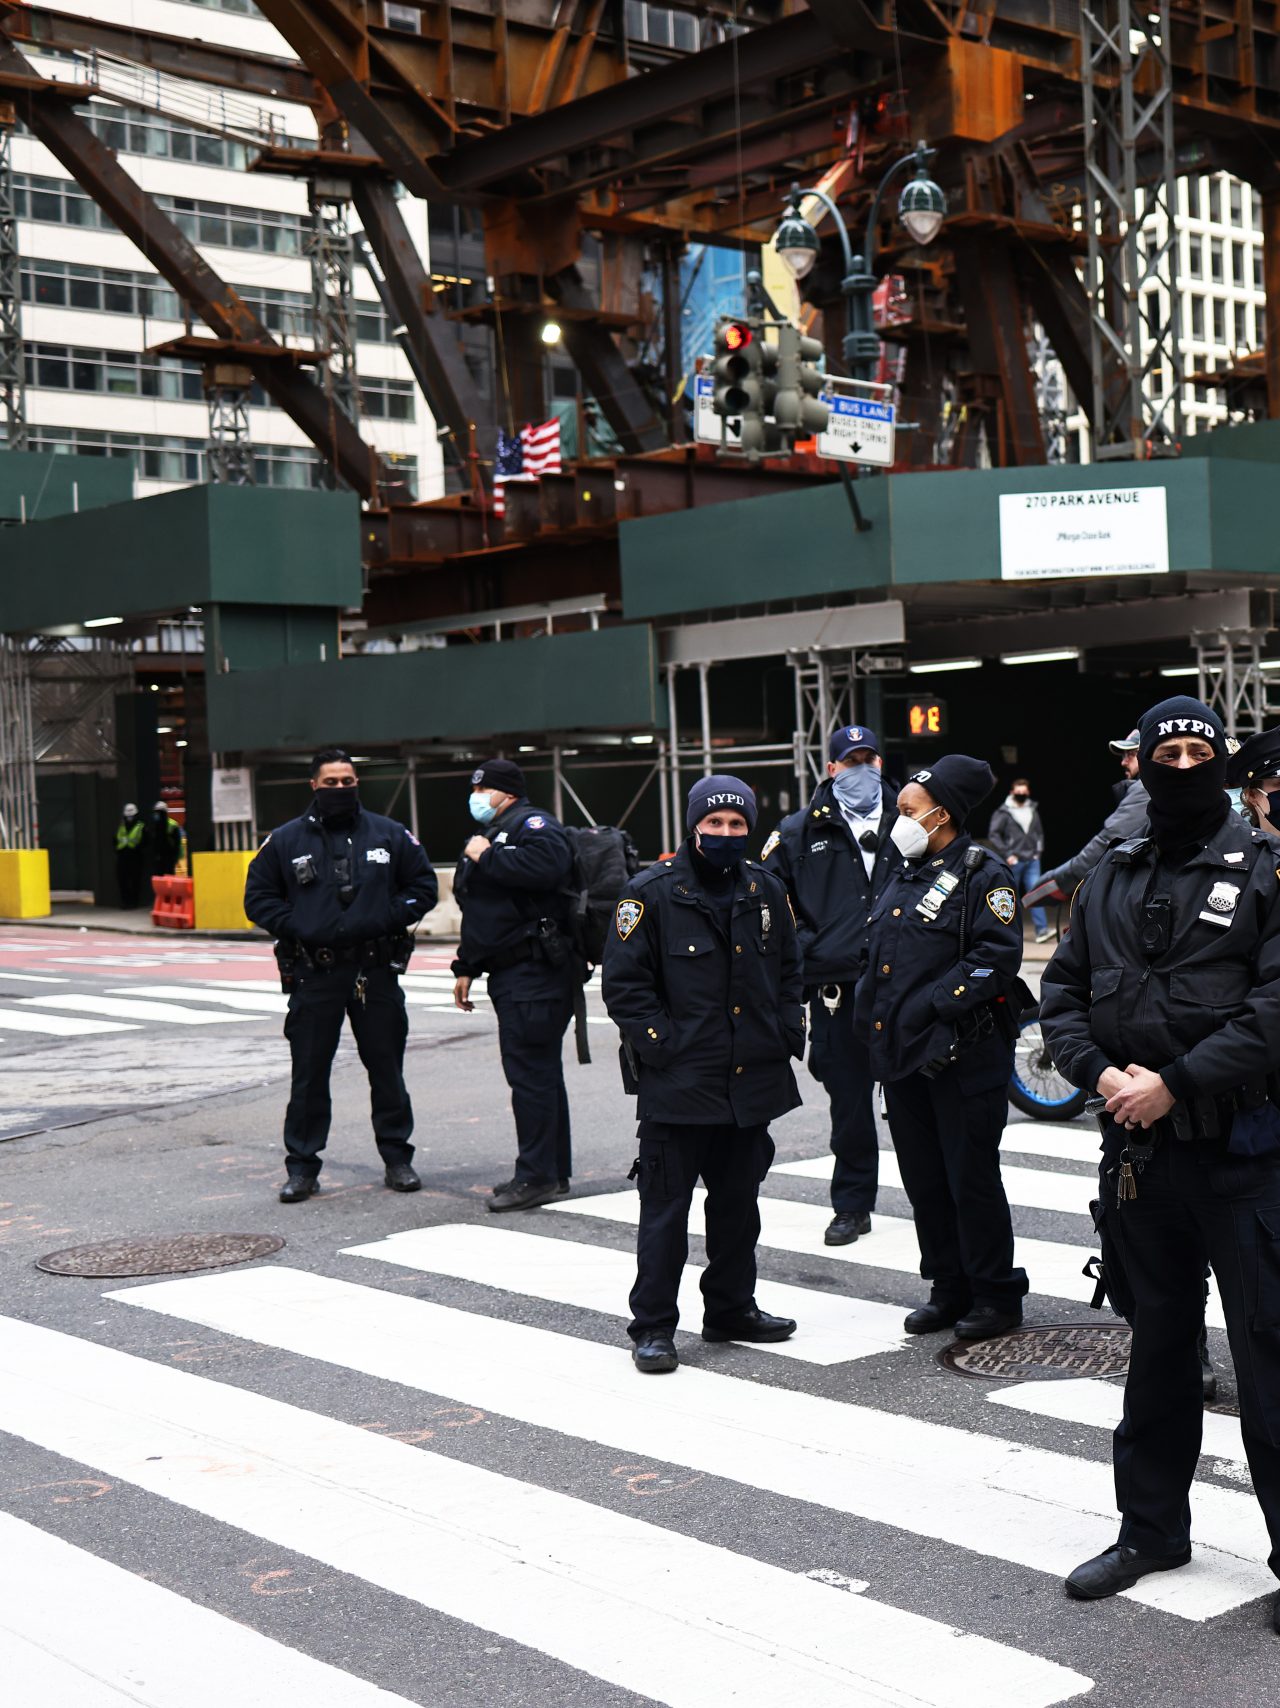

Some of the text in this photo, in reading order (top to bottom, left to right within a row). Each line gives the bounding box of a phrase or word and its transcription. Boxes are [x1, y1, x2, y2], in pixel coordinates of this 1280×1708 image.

[839, 401, 861, 414] BUS
[860, 419, 882, 431] ONLY
[1026, 491, 1140, 508] 270 PARK AVENUE
[1157, 718, 1216, 739] NYPD
[707, 793, 745, 807] NYPD
